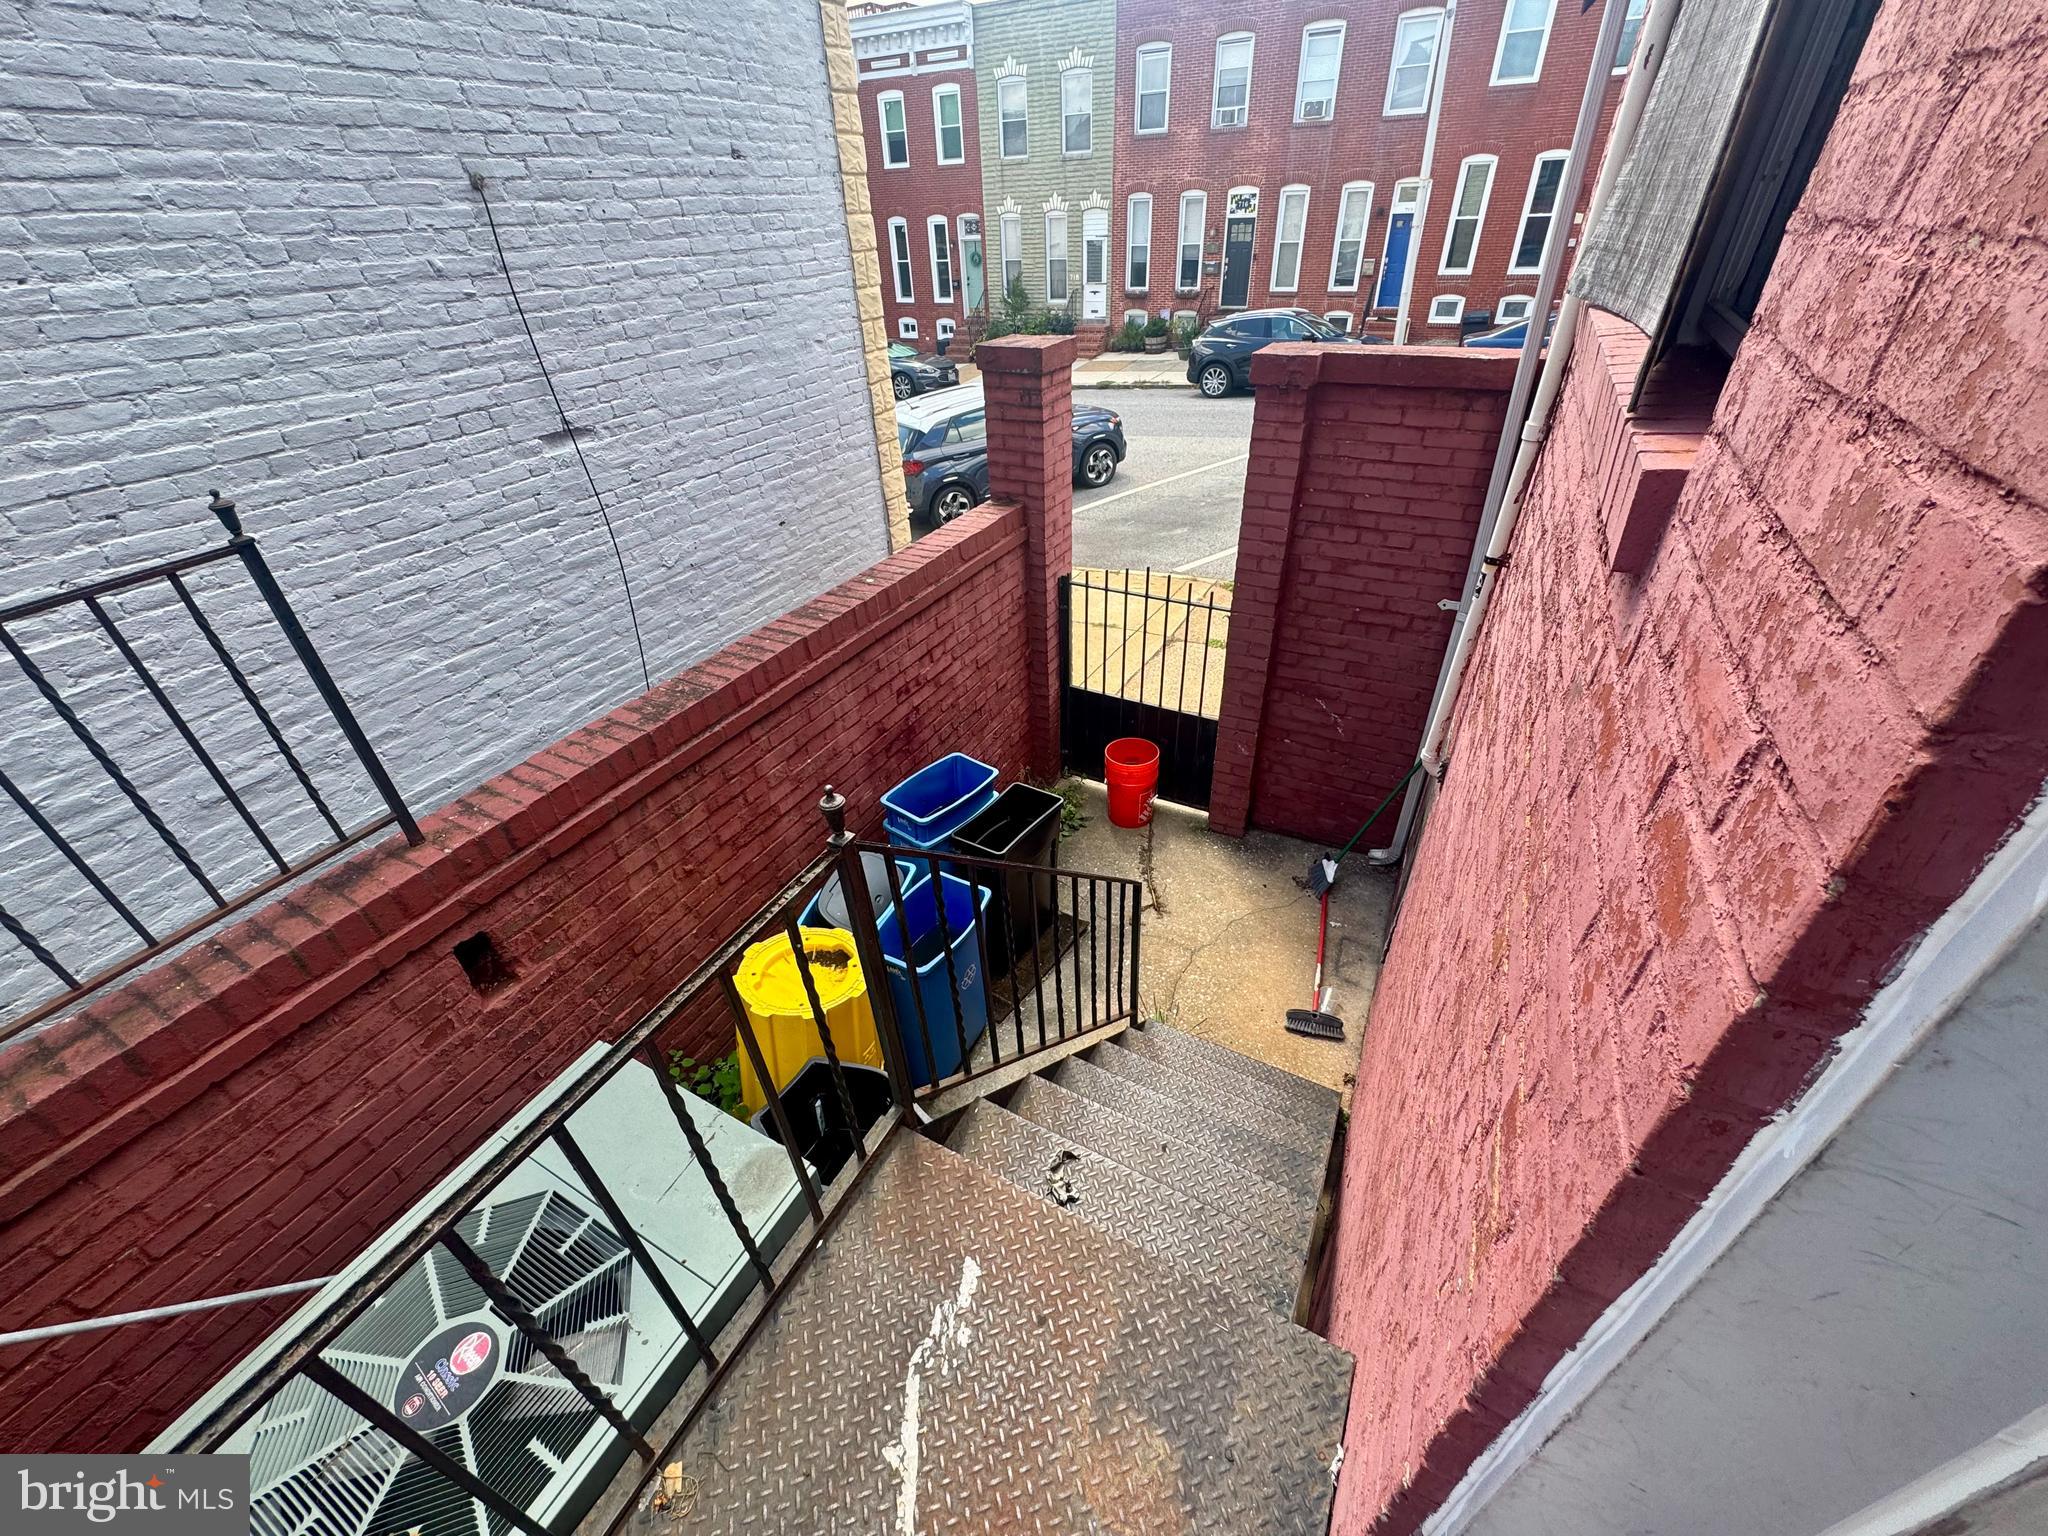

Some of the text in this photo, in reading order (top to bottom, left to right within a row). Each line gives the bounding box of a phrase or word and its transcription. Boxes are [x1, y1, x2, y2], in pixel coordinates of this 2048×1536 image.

[426, 1369, 449, 1399] 10 SEER
[435, 1357, 460, 1392] Classic
